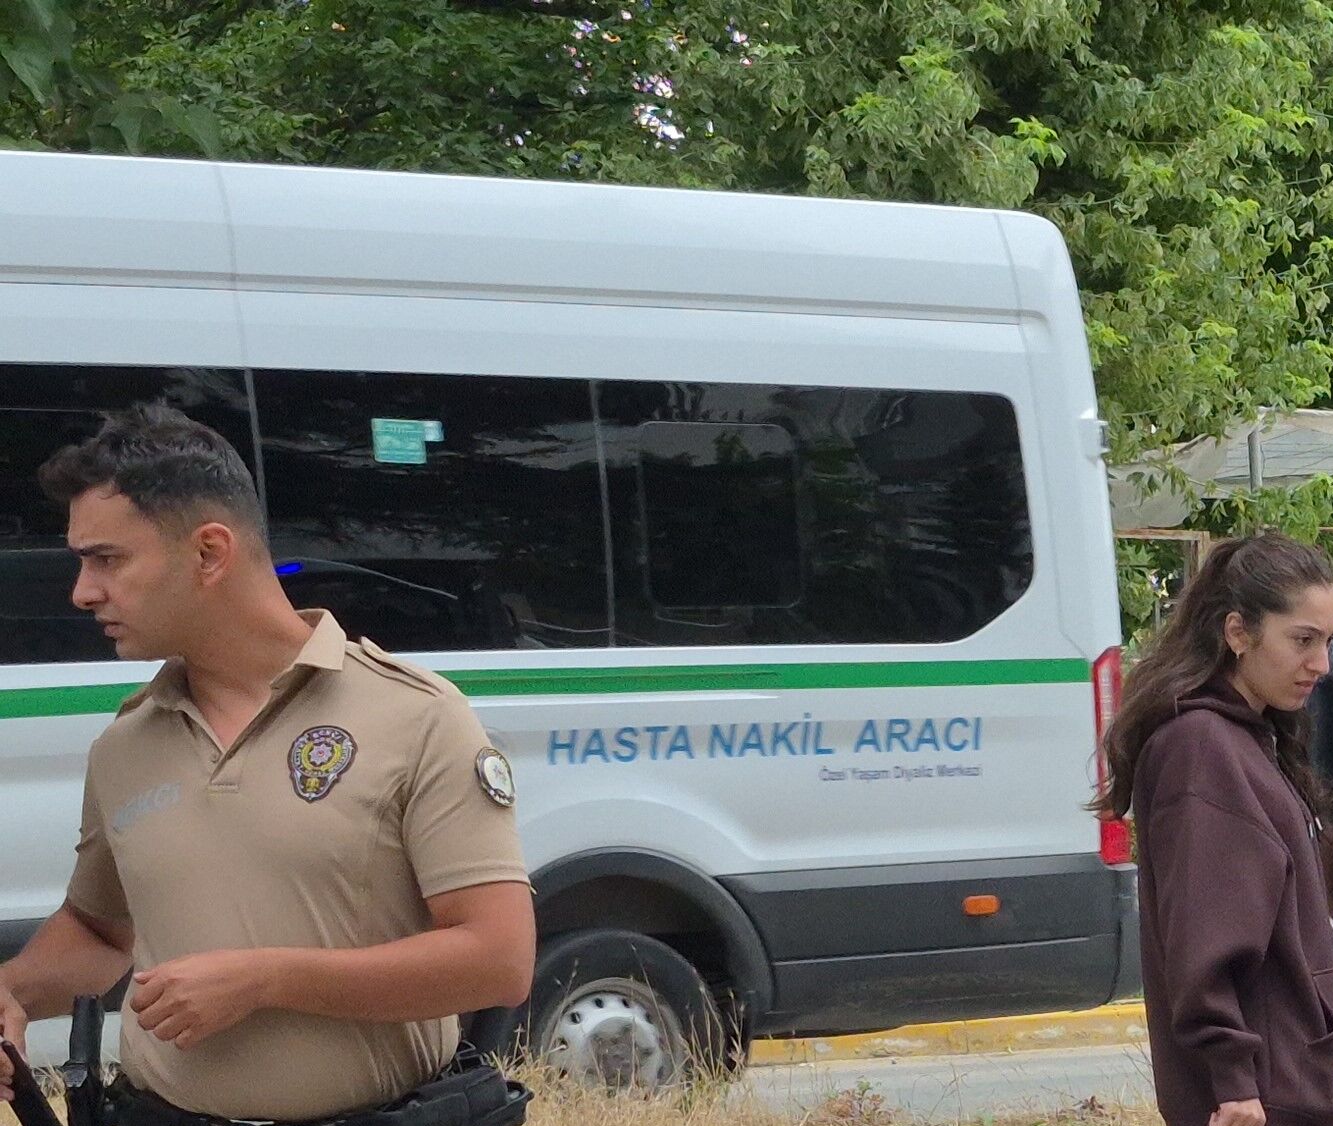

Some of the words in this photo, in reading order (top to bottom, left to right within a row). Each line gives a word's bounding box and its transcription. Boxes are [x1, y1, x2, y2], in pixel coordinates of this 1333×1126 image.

[546, 724, 695, 766] HASTA
[707, 711, 836, 759] NAKİL
[853, 716, 983, 754] ARACI
